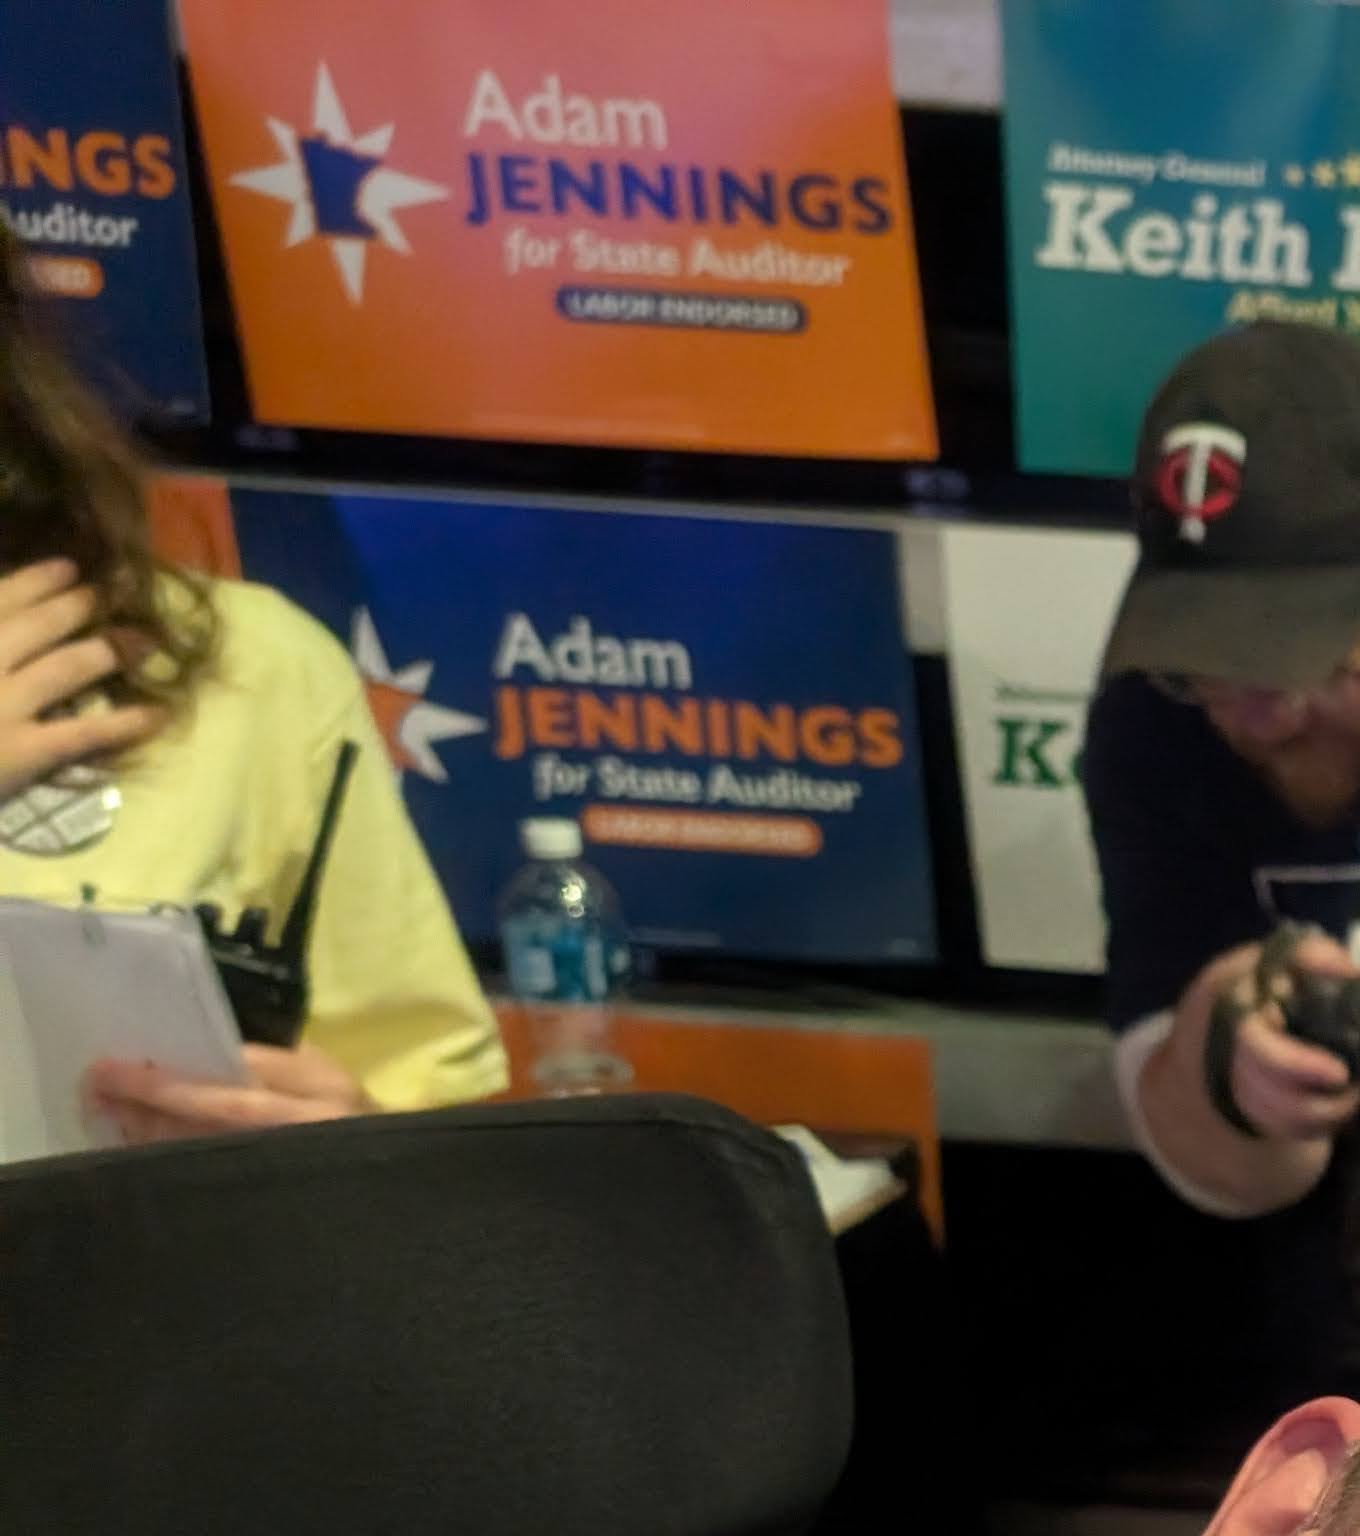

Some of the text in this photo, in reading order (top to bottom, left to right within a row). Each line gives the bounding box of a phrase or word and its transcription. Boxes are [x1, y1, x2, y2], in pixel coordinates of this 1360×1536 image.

[464, 69, 667, 149] Adam
[0, 124, 177, 200] NGS
[463, 152, 893, 234] JENNINGS
[506, 225, 854, 288] for State Auditor
[1035, 180, 1310, 289] Keith
[494, 612, 694, 690] Adam
[494, 686, 904, 769] JENNINGS
[533, 751, 861, 813] for State Auditor
